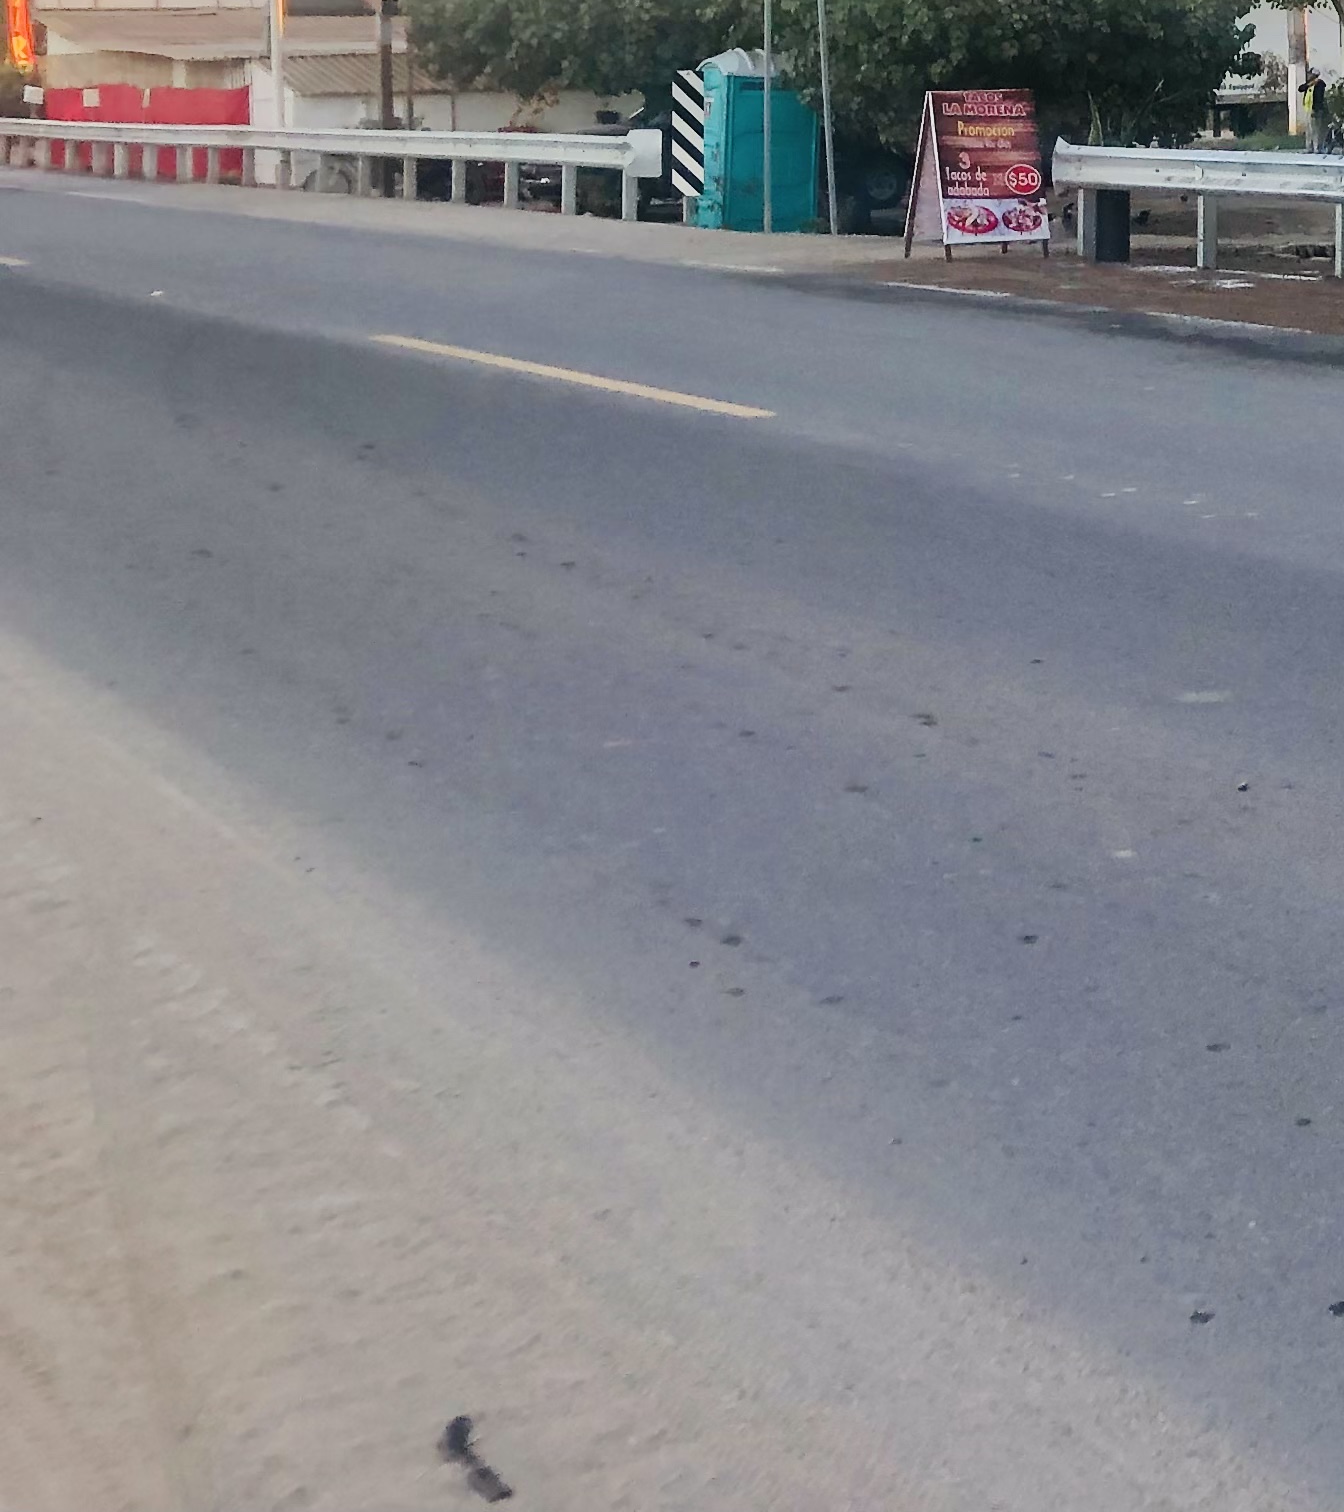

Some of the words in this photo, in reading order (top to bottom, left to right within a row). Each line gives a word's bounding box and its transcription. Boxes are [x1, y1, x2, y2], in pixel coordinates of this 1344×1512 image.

[963, 91, 1002, 103] TACOS
[942, 102, 962, 116] LA
[963, 102, 1026, 117] MORENA
[958, 151, 971, 169] 3
[975, 165, 987, 181] de
[1008, 171, 1038, 188] $50
[947, 181, 990, 196] adobada
